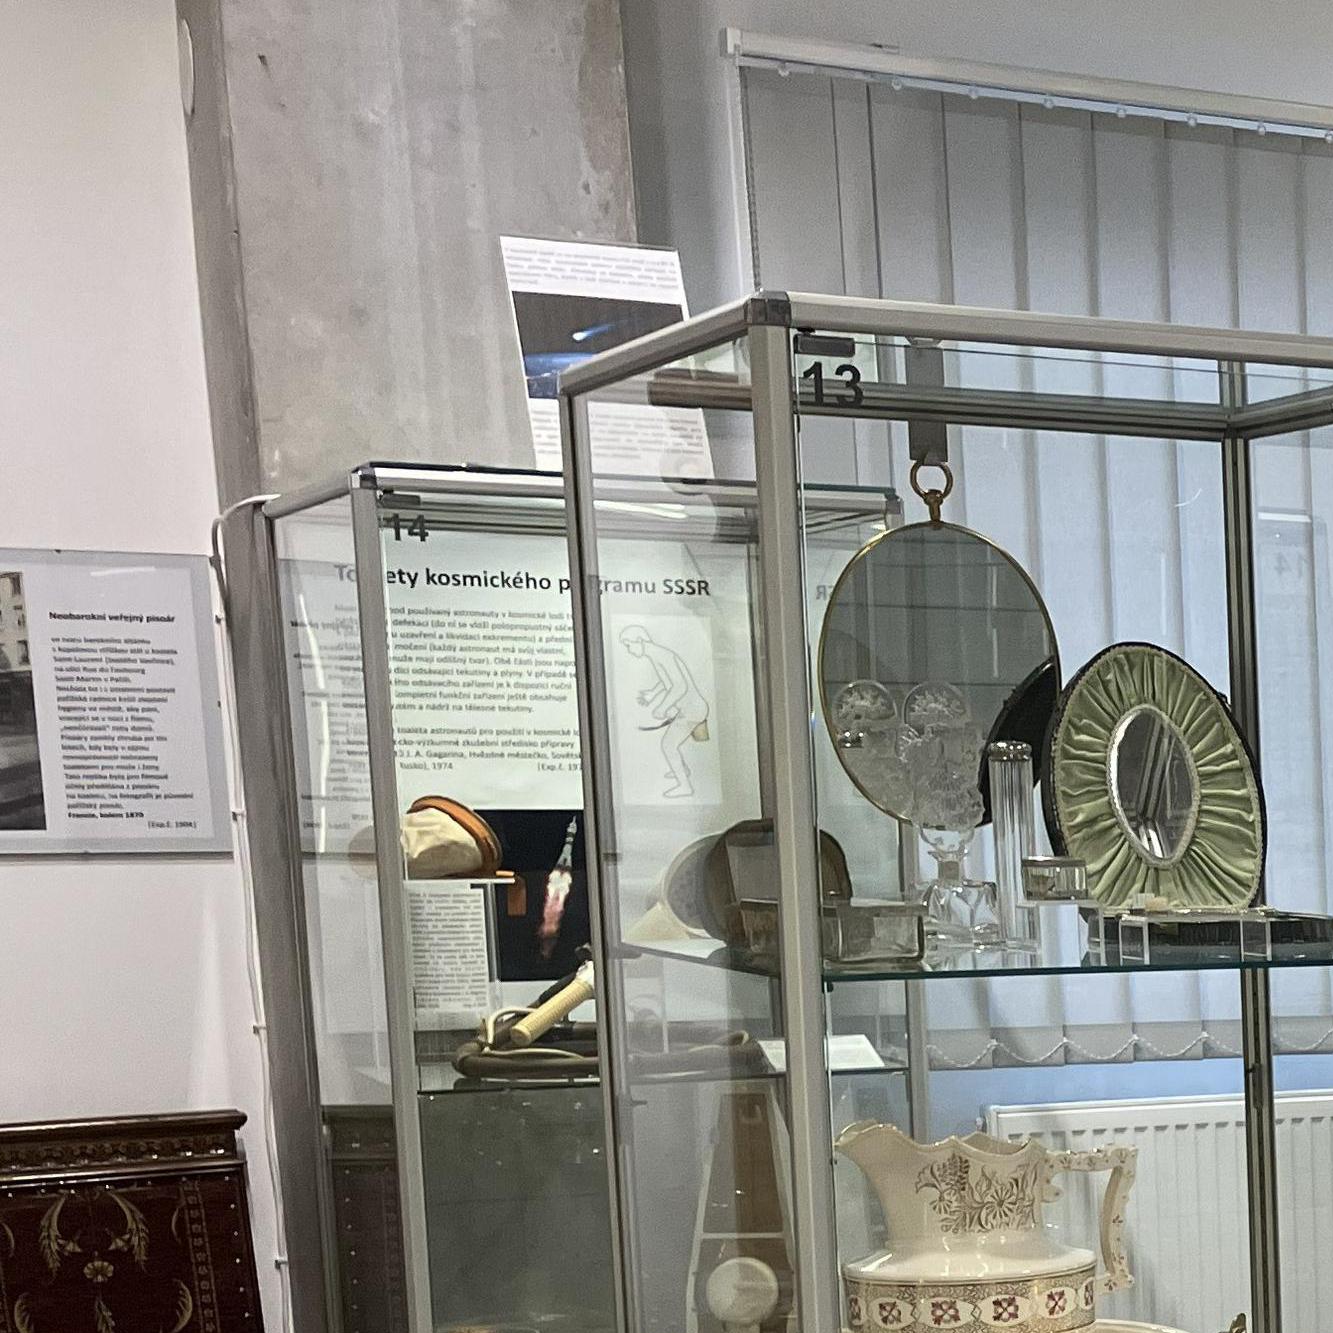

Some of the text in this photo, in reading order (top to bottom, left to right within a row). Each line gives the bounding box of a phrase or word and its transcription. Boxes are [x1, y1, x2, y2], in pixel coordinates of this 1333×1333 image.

[803, 362, 863, 406] 13
[393, 513, 429, 541] 14
[426, 568, 550, 592] kosmického
[662, 579, 711, 596] SSSR
